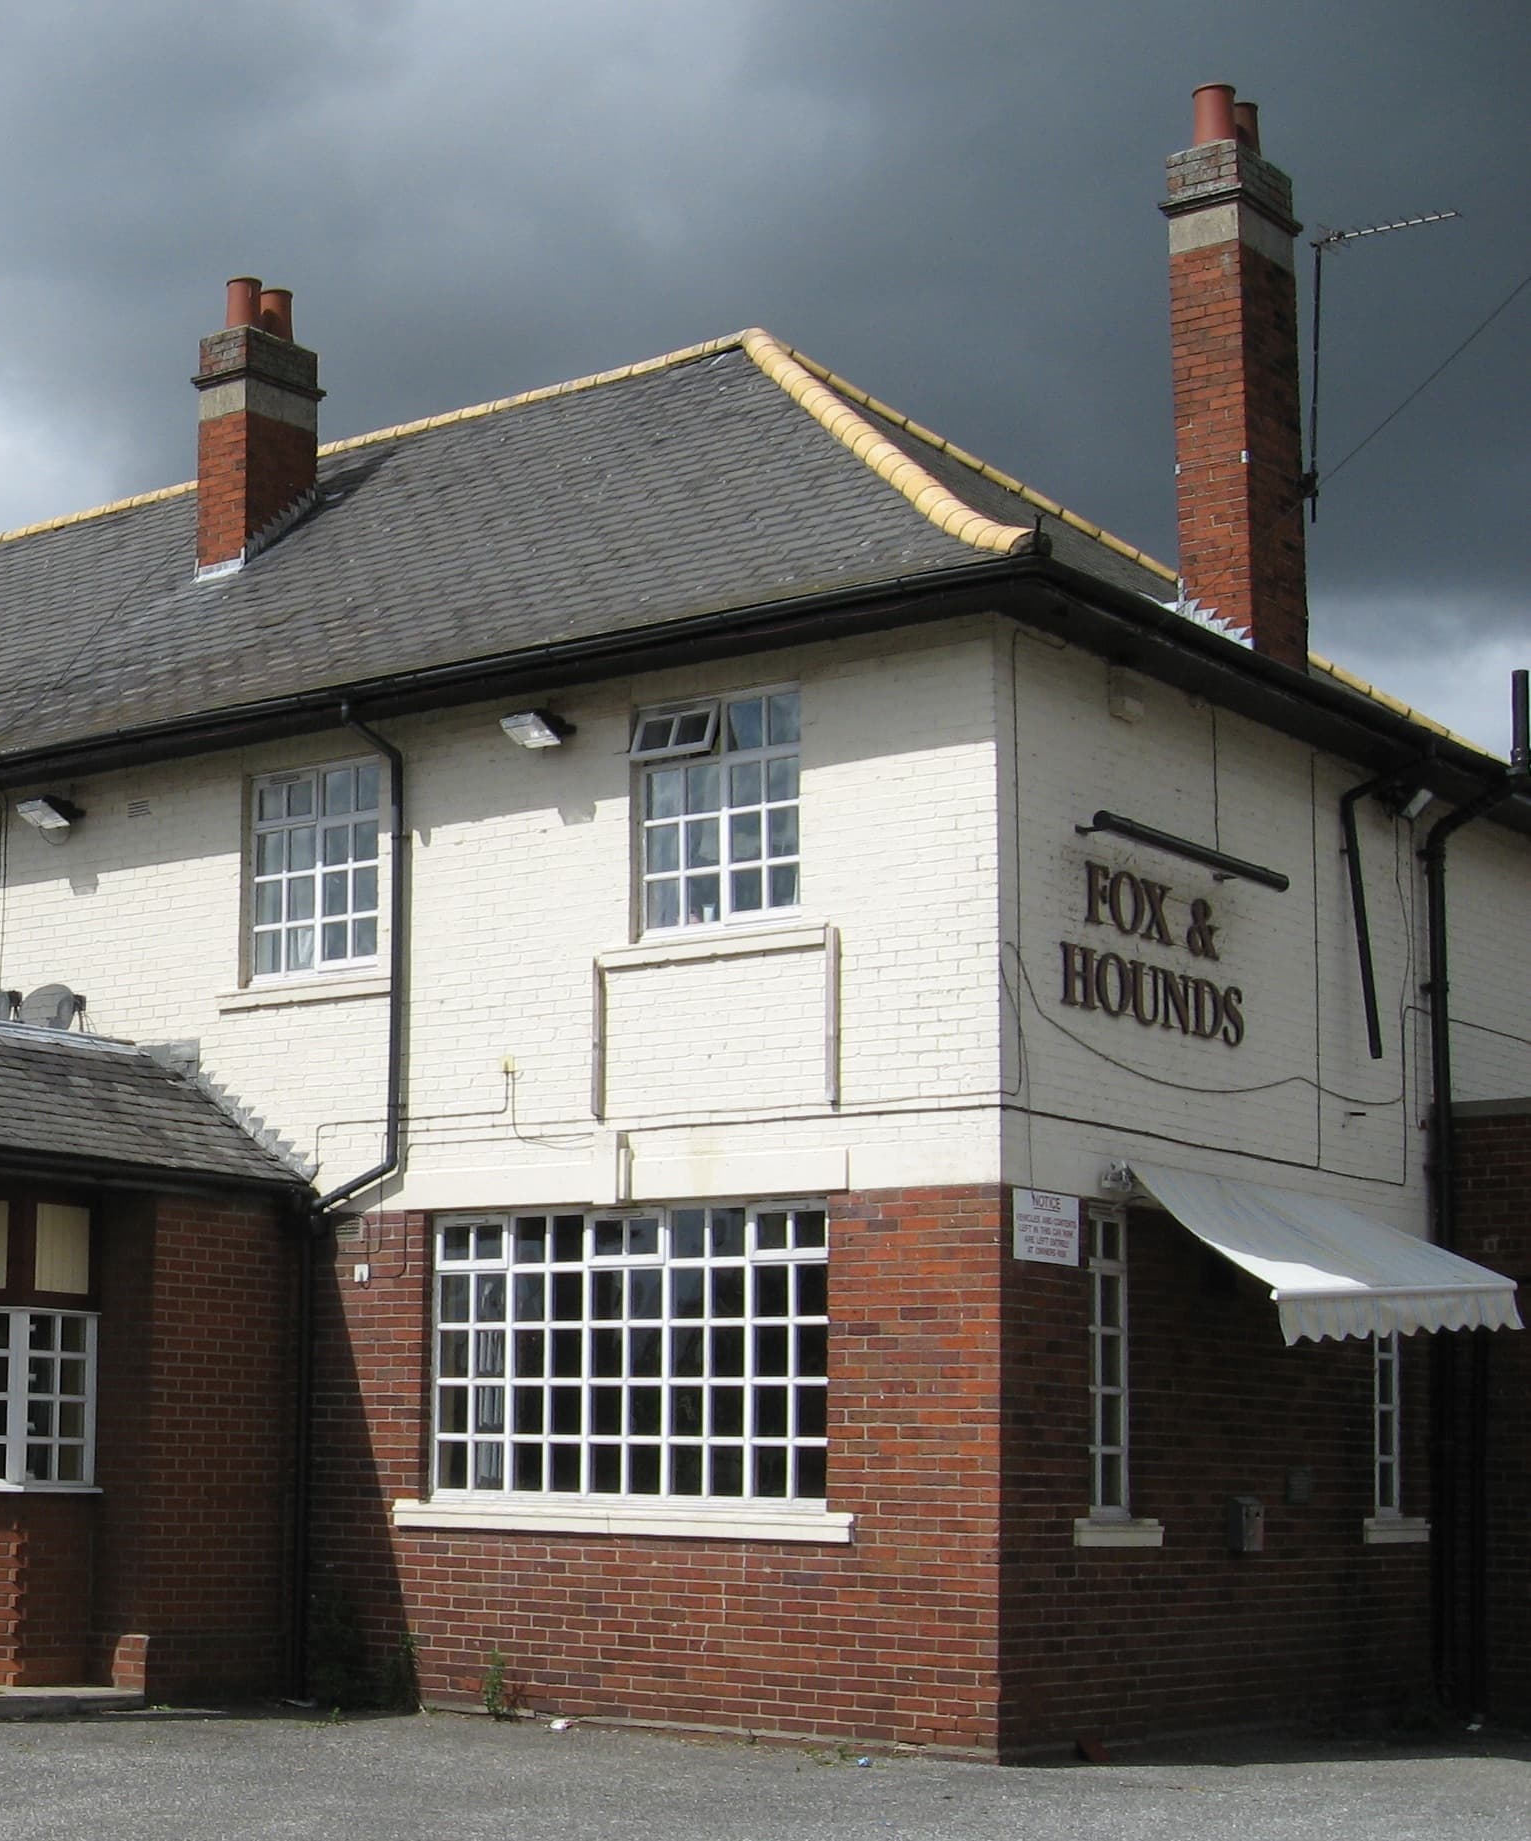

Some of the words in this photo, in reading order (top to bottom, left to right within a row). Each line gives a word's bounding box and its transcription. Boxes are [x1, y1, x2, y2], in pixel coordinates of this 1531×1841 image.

[1084, 860, 1174, 945] FOX
[1186, 898, 1219, 961] &
[1060, 941, 1245, 1047] HOUNDS
[1031, 1193, 1061, 1210] NOTICE
